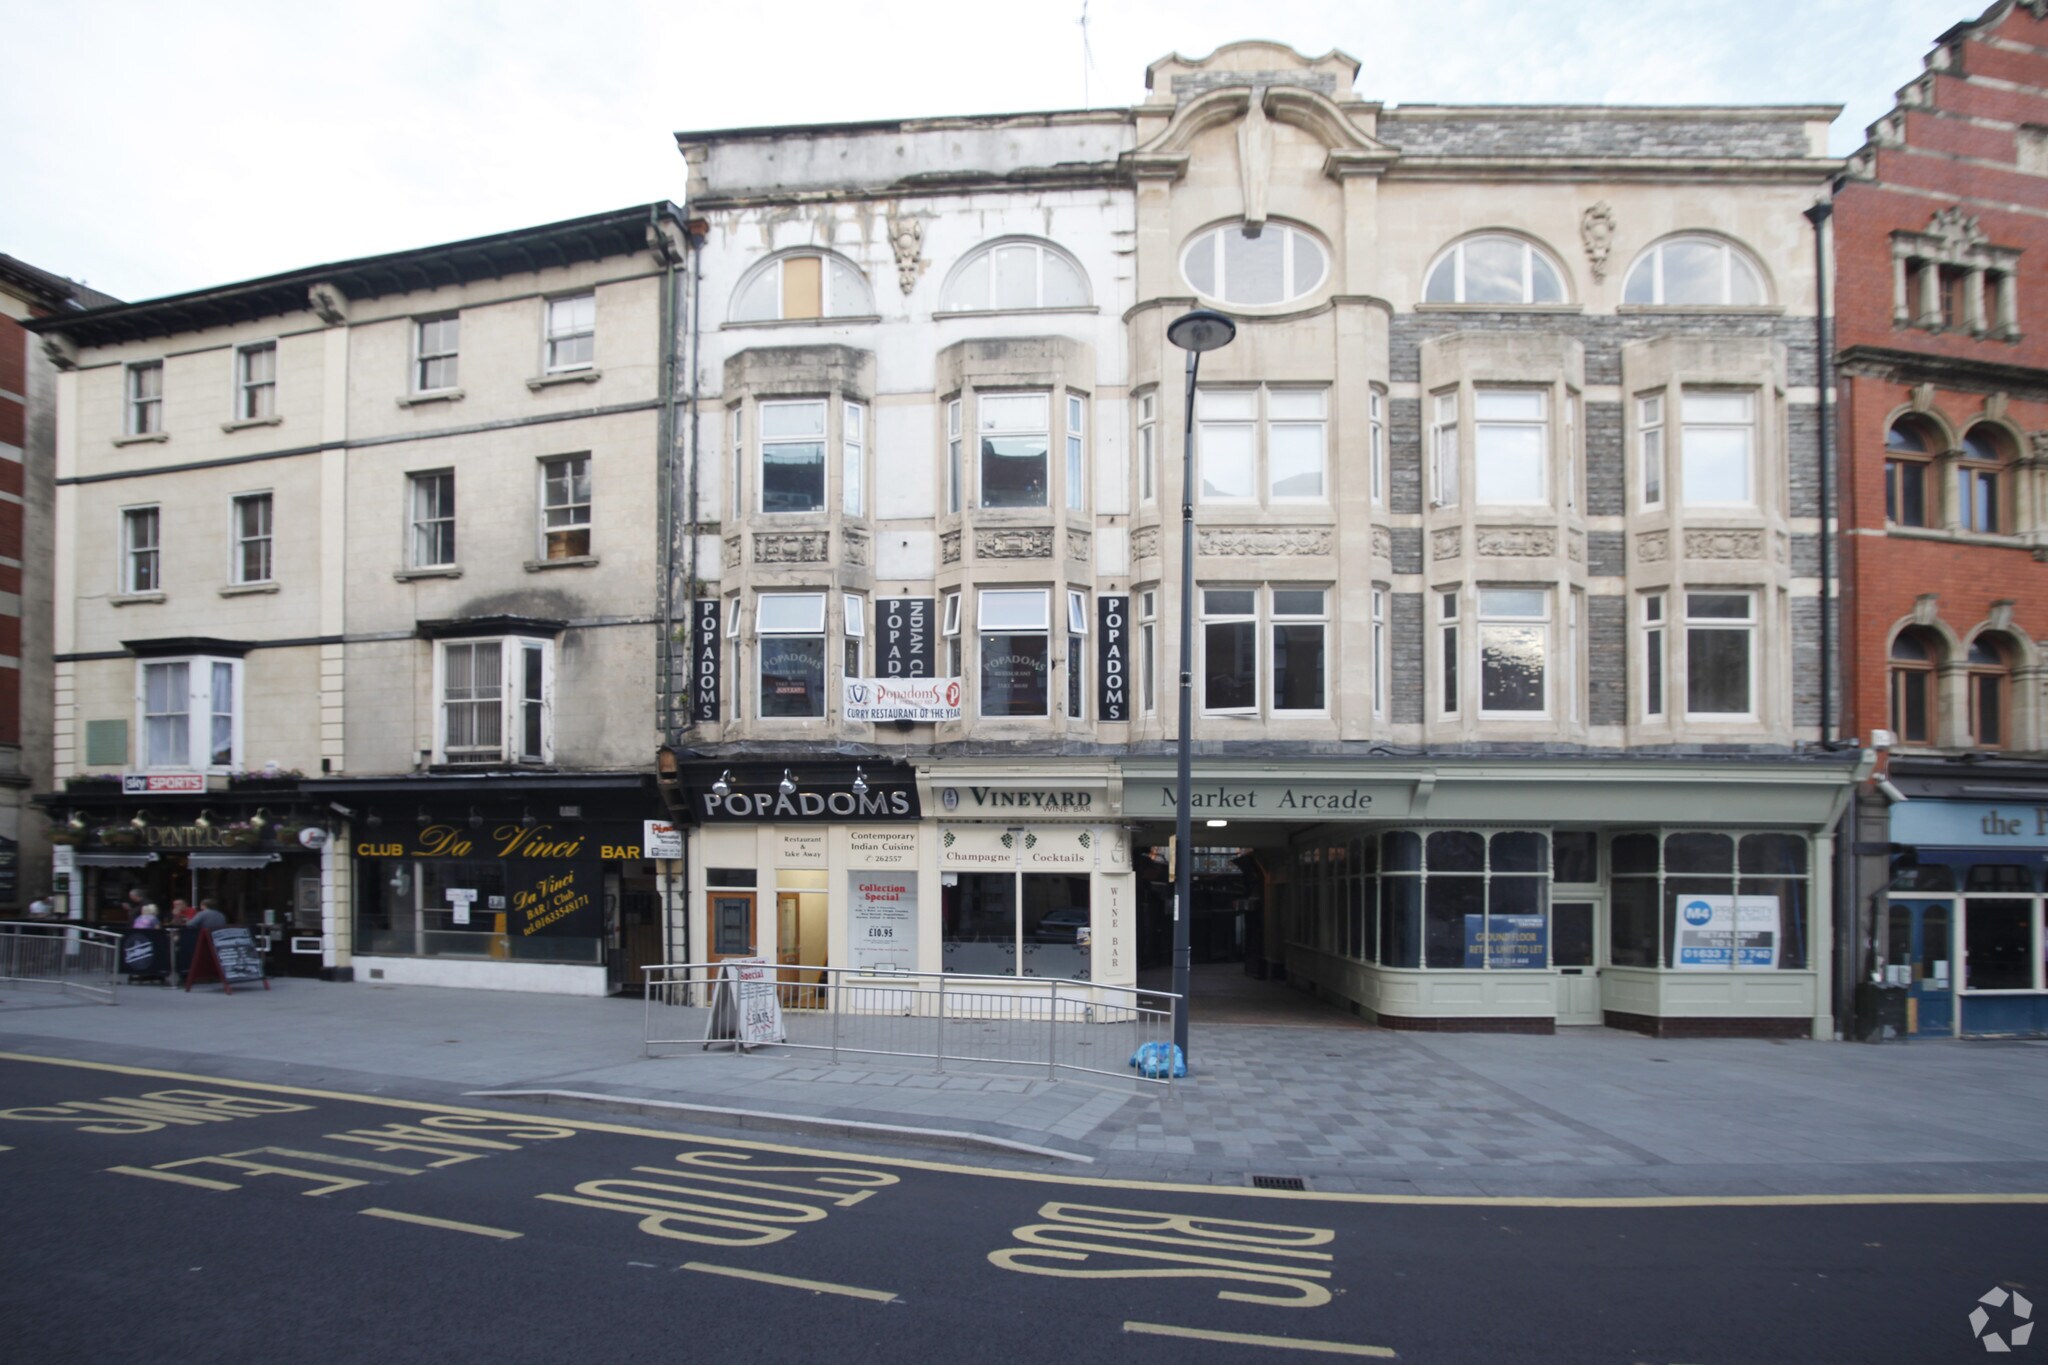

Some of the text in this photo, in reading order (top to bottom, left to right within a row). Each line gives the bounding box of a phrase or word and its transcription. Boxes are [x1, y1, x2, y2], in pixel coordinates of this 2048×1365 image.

[910, 601, 924, 654] INDIAN
[887, 600, 902, 678] POPAD
[700, 602, 717, 719] POPADOMS
[762, 652, 824, 670] POPADOMS
[983, 654, 1046, 672] POPADOMS
[1106, 598, 1123, 719] POPADOMS
[847, 707, 960, 719] CURRY RESTAURANT OF THE YEAR
[149, 777, 200, 789] SPORTS
[703, 791, 909, 816] POPADOMS
[1161, 787, 1373, 809] Market Arcade
[1981, 810, 2022, 836] the
[357, 824, 641, 859] CLUB Da Vinci BAR
[851, 832, 915, 841] Contemporary
[851, 843, 915, 851] Indian Cuisine
[946, 852, 1085, 863] Champagne Cocktails
[513, 891, 537, 911] Da
[536, 870, 574, 898] Vinci
[859, 884, 906, 893] Collection
[553, 889, 575, 906] Club
[865, 893, 900, 902] Special
[1110, 887, 1119, 928] WINE
[1686, 907, 1710, 919] M4
[868, 928, 893, 938] £10.95
[1509, 932, 1537, 942] FLOOR
[1518, 944, 1529, 954] TO
[1530, 944, 1543, 954] LET
[1711, 939, 1747, 947] TO LT
[1683, 949, 1722, 958] 01633
[1724, 950, 1746, 959] 70
[534, 1151, 901, 1247] STOP
[988, 1202, 1335, 1308] BUS
